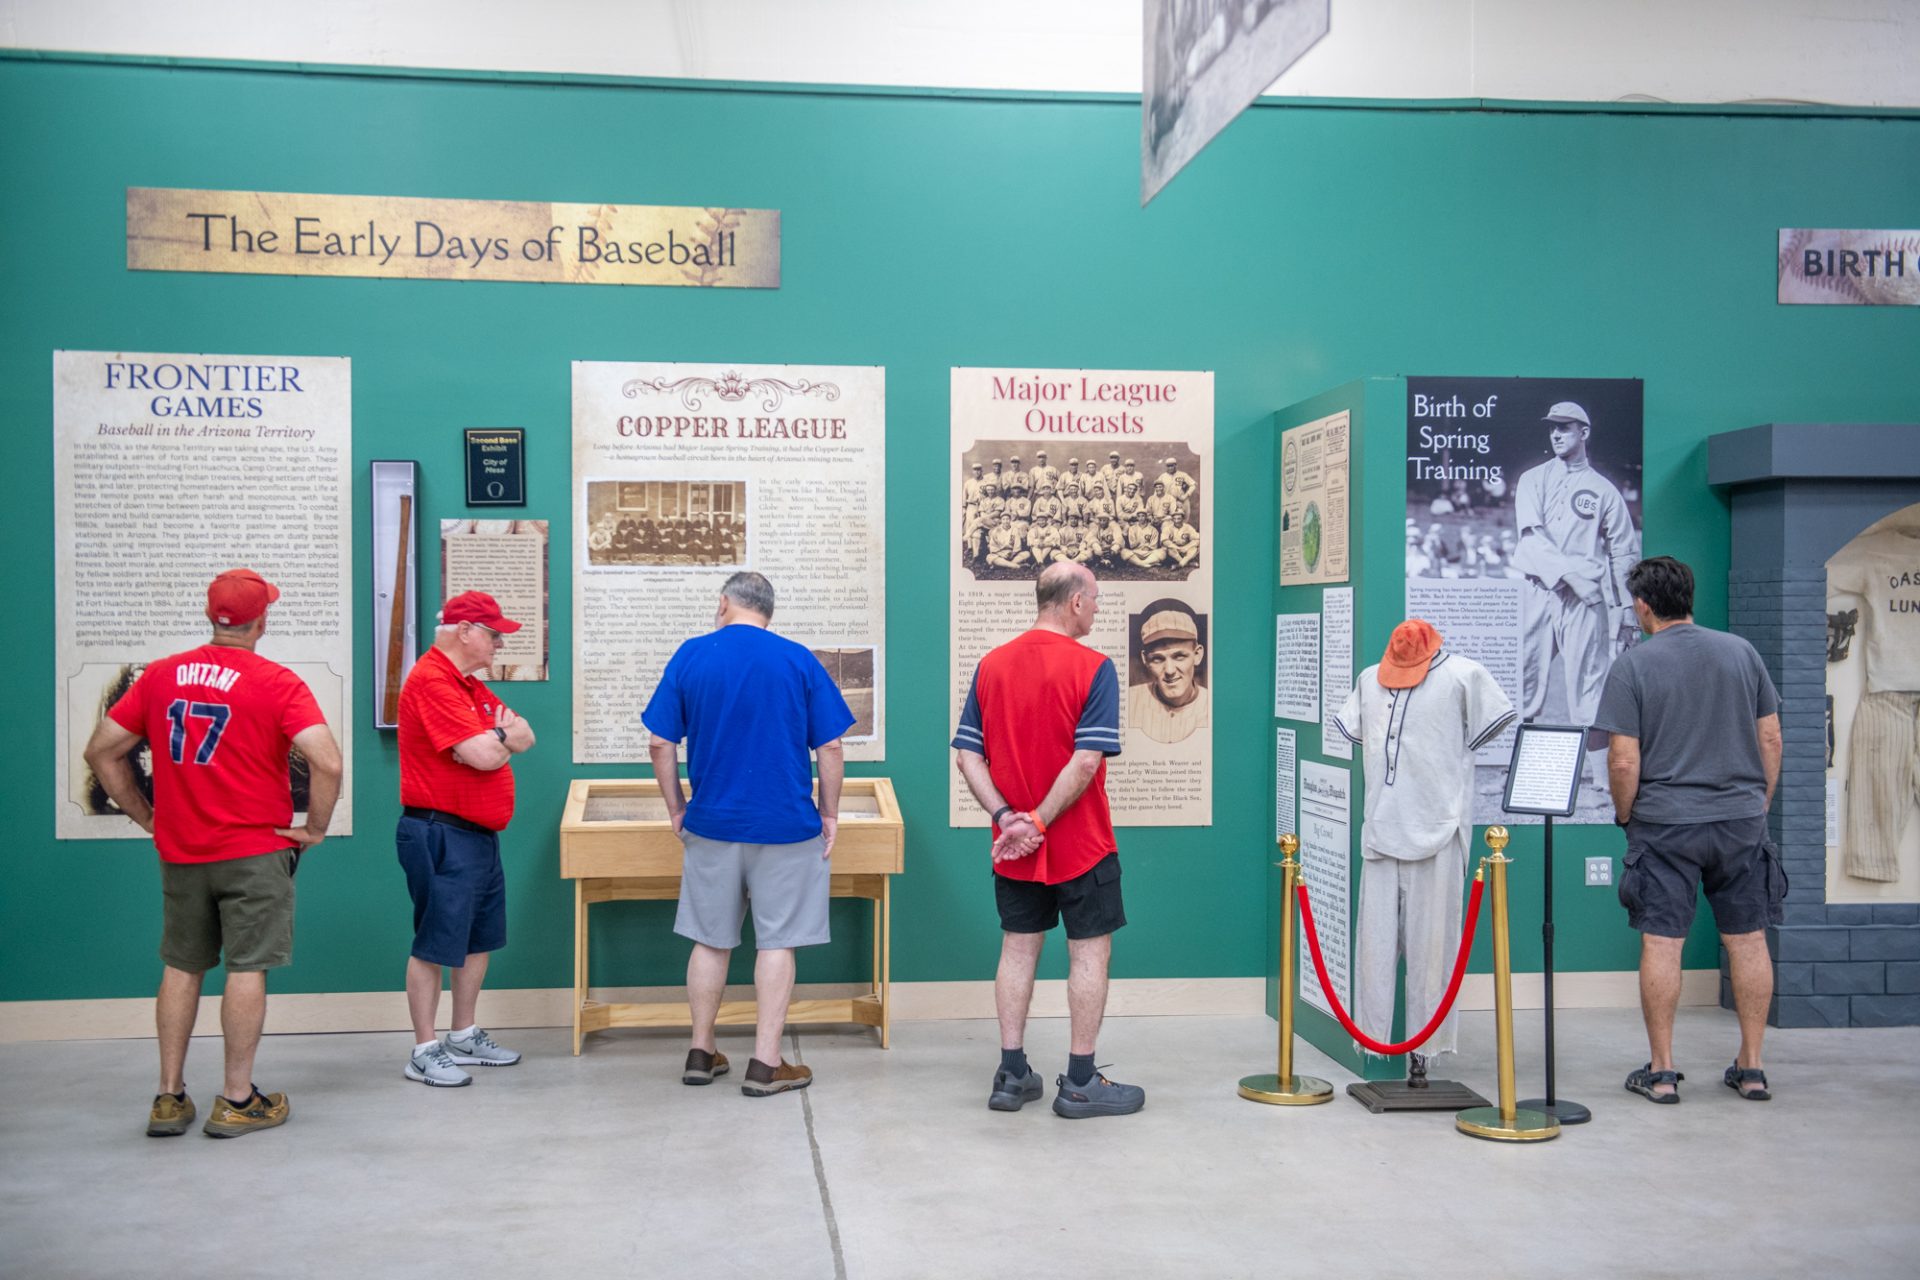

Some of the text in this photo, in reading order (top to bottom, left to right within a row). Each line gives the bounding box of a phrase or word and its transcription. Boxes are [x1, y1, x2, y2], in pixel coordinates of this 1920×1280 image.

[186, 213, 735, 268] The Early Days of Baseball
[1804, 249, 1905, 277] BIRTH
[104, 362, 304, 392] FRONTIER
[992, 376, 1177, 407] Major League
[151, 395, 263, 419] GAMES
[1414, 394, 1497, 418] Birth of
[97, 423, 316, 441] Baseball in the Arizona Territory
[617, 415, 847, 440] COPPER LEAGUE
[1025, 408, 1144, 434] Outcasts
[1420, 426, 1490, 454] Spring
[1407, 456, 1502, 485] Training
[177, 662, 242, 693] OHTANI
[166, 698, 232, 765] 17
